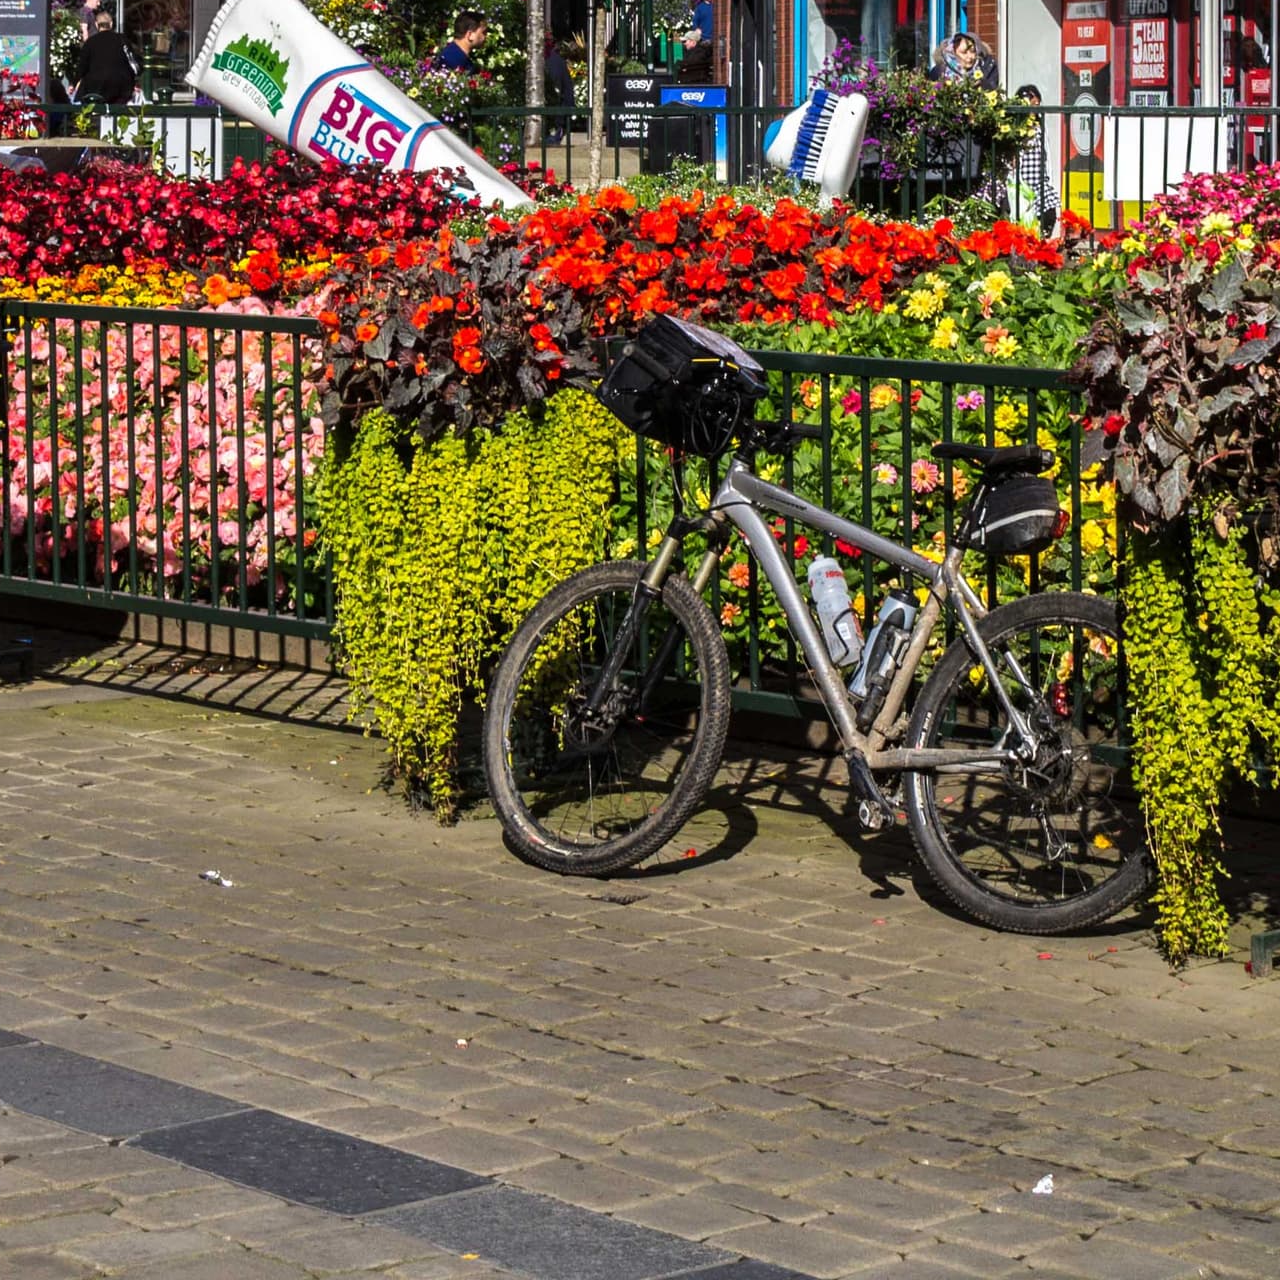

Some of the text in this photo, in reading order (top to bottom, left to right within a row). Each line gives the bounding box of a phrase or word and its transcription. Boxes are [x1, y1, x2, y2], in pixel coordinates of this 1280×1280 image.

[1132, 21, 1165, 64] 5 TEAM
[1143, 42, 1165, 63] ACCA
[248, 46, 277, 72] RHS
[1132, 64, 1165, 79] INSURANCE
[226, 54, 278, 101] Greening
[625, 80, 653, 91] easy
[681, 92, 705, 102] easy
[321, 87, 407, 165] BIG
[311, 120, 377, 165] Brus
